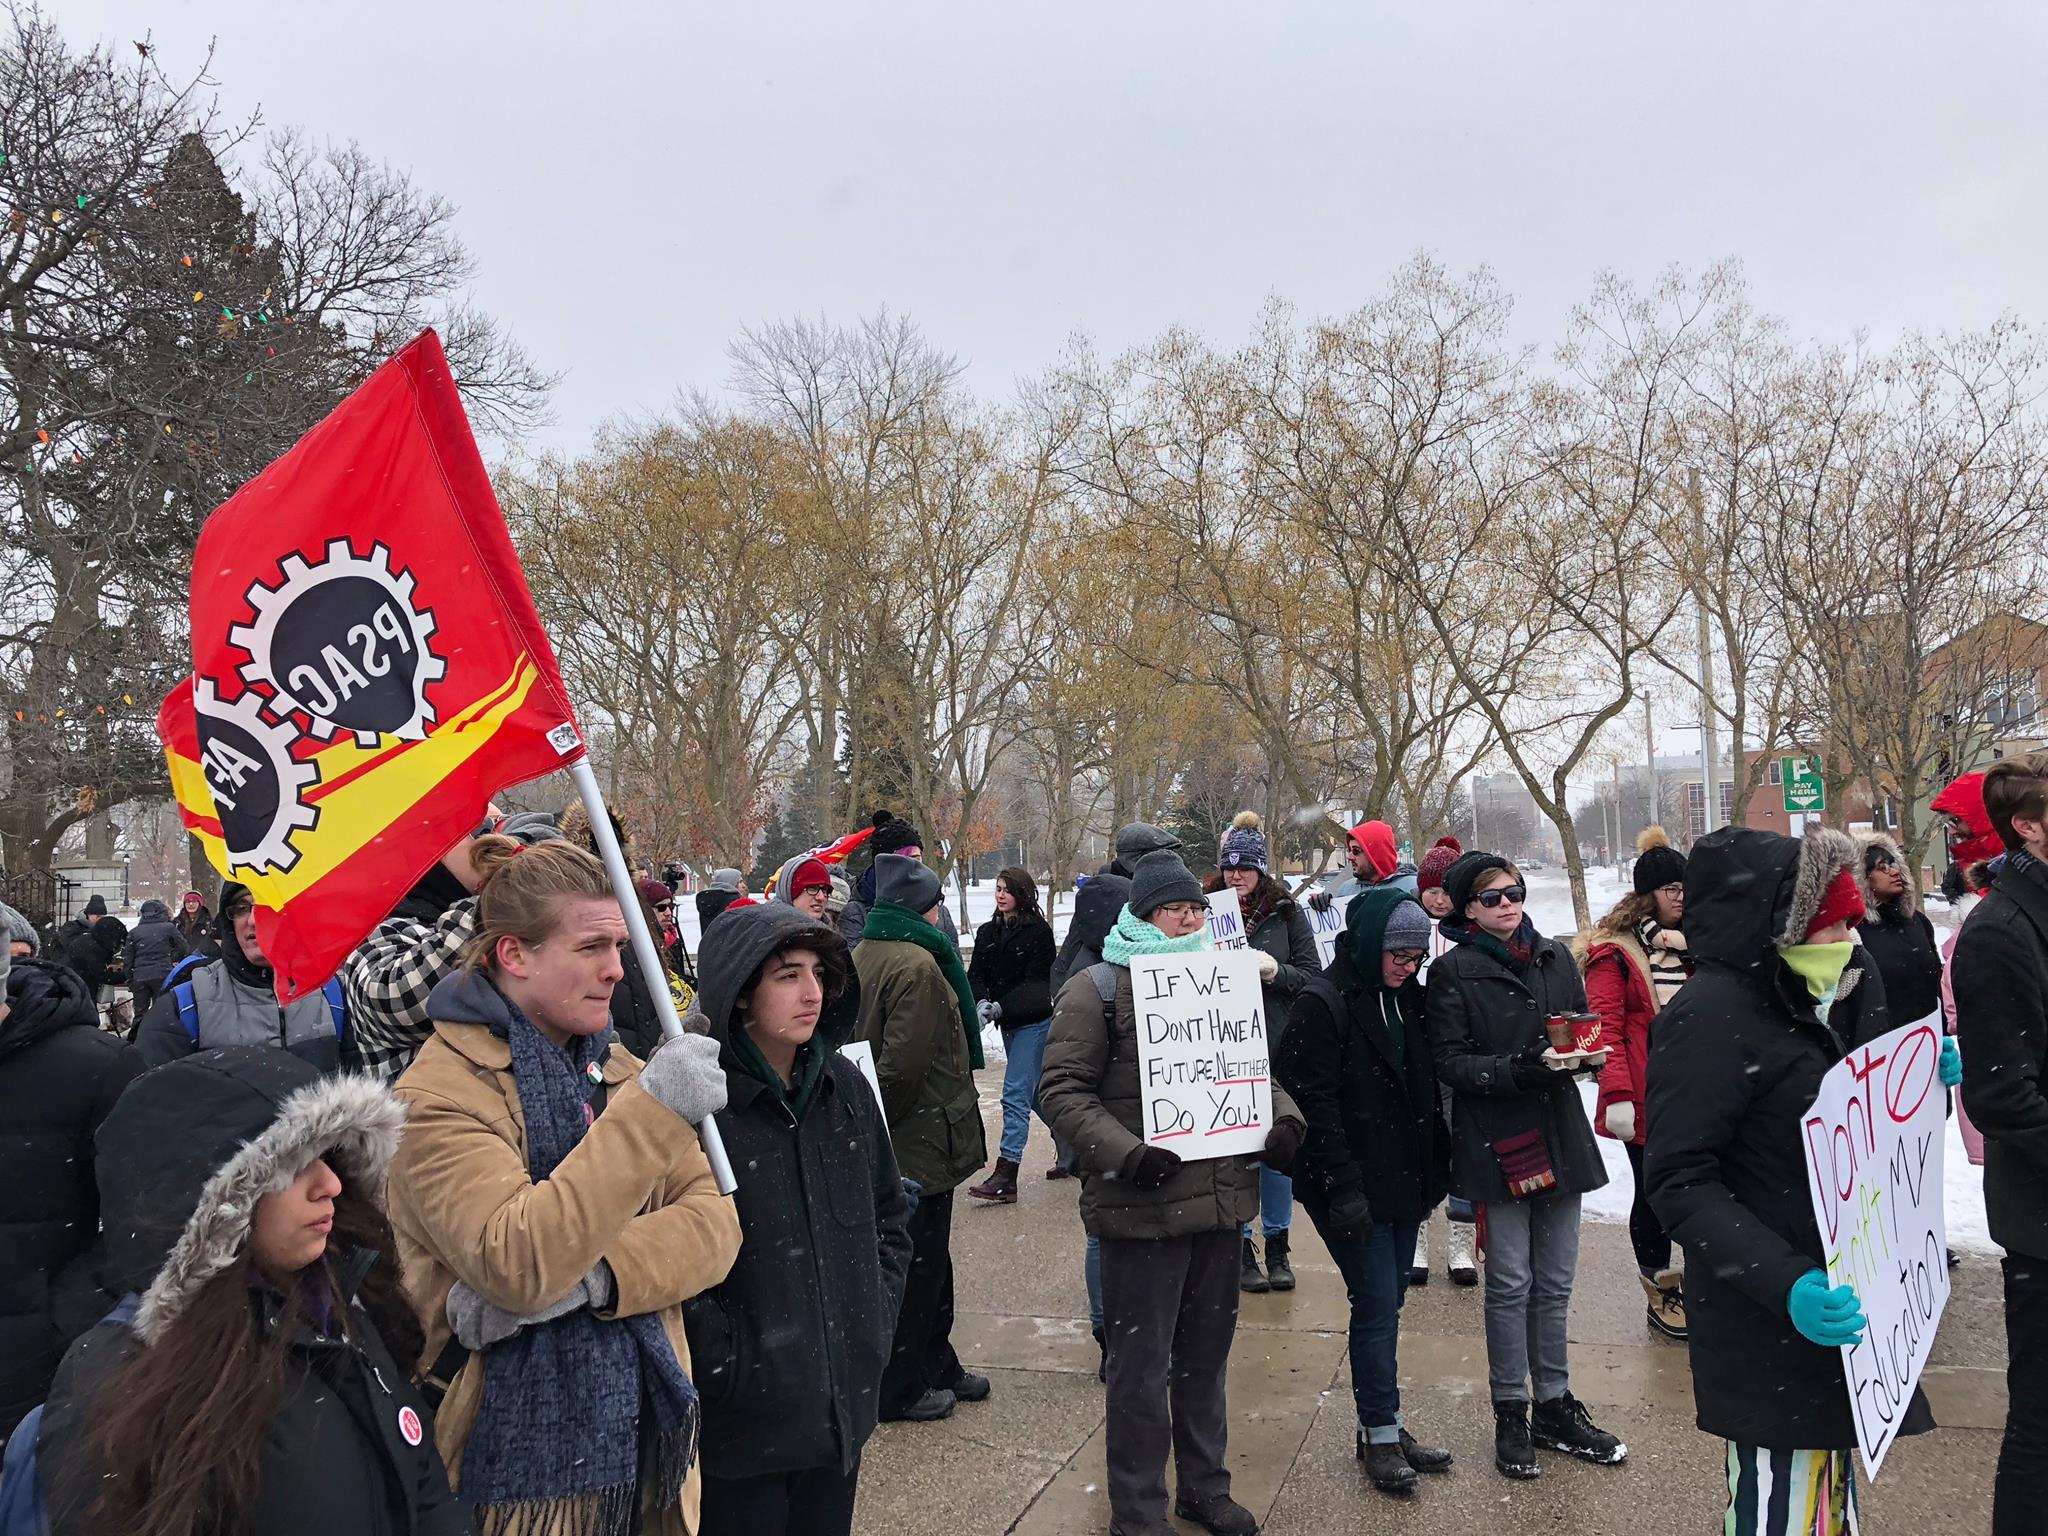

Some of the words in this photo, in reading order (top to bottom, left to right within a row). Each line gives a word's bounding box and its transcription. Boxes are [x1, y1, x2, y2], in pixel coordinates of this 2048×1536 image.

[1207, 911, 1237, 939] TION
[1142, 968, 1181, 1000] IF
[1185, 965, 1231, 996] WE
[1207, 1008, 1248, 1043] HAVE
[1250, 1008, 1262, 1040] A
[1576, 1022, 1602, 1050] Horto
[1151, 1098, 1195, 1134] DO
[1206, 1080, 1260, 1130] YOU!
[1849, 1229, 1944, 1464] Education
